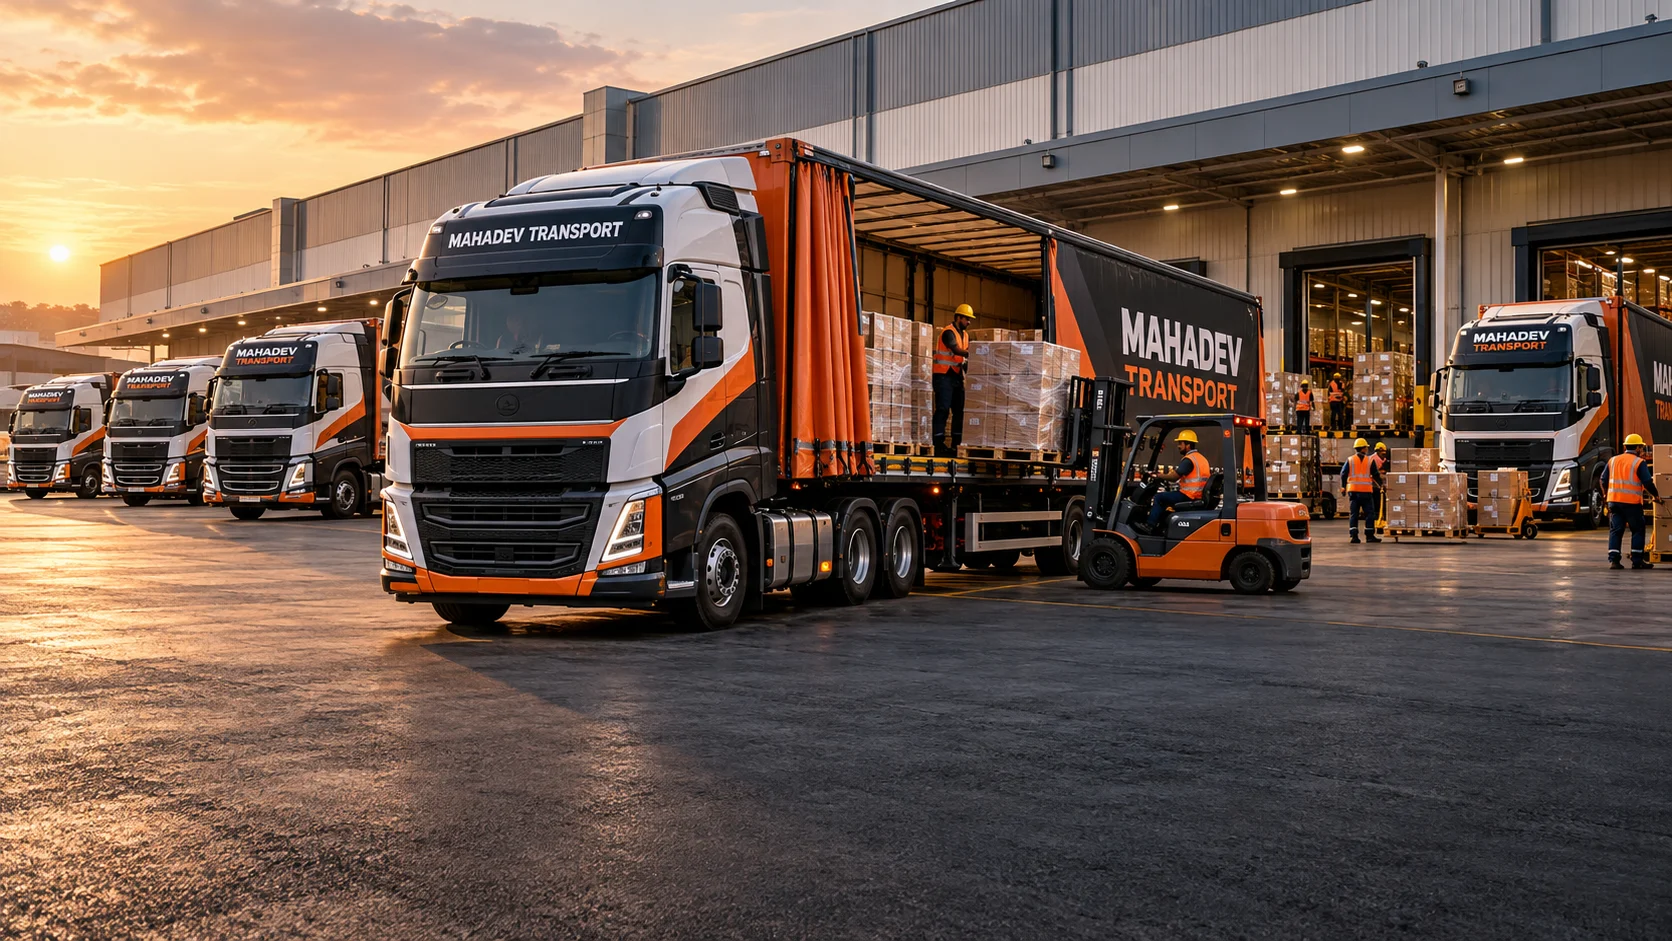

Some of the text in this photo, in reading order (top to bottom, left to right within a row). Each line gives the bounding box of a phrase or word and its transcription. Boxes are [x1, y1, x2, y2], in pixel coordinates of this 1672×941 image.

[447, 221, 624, 249] MAHADEV TRANSPORT
[1121, 307, 1243, 377] MAHADEV
[1473, 330, 1550, 343] MAHADEV
[236, 346, 298, 357] MAHADEV
[1473, 341, 1547, 352] TRANSPORT
[235, 356, 294, 365] TRANSPORT
[126, 375, 175, 384] MAHADEV
[1124, 364, 1239, 410] TRANSPORT
